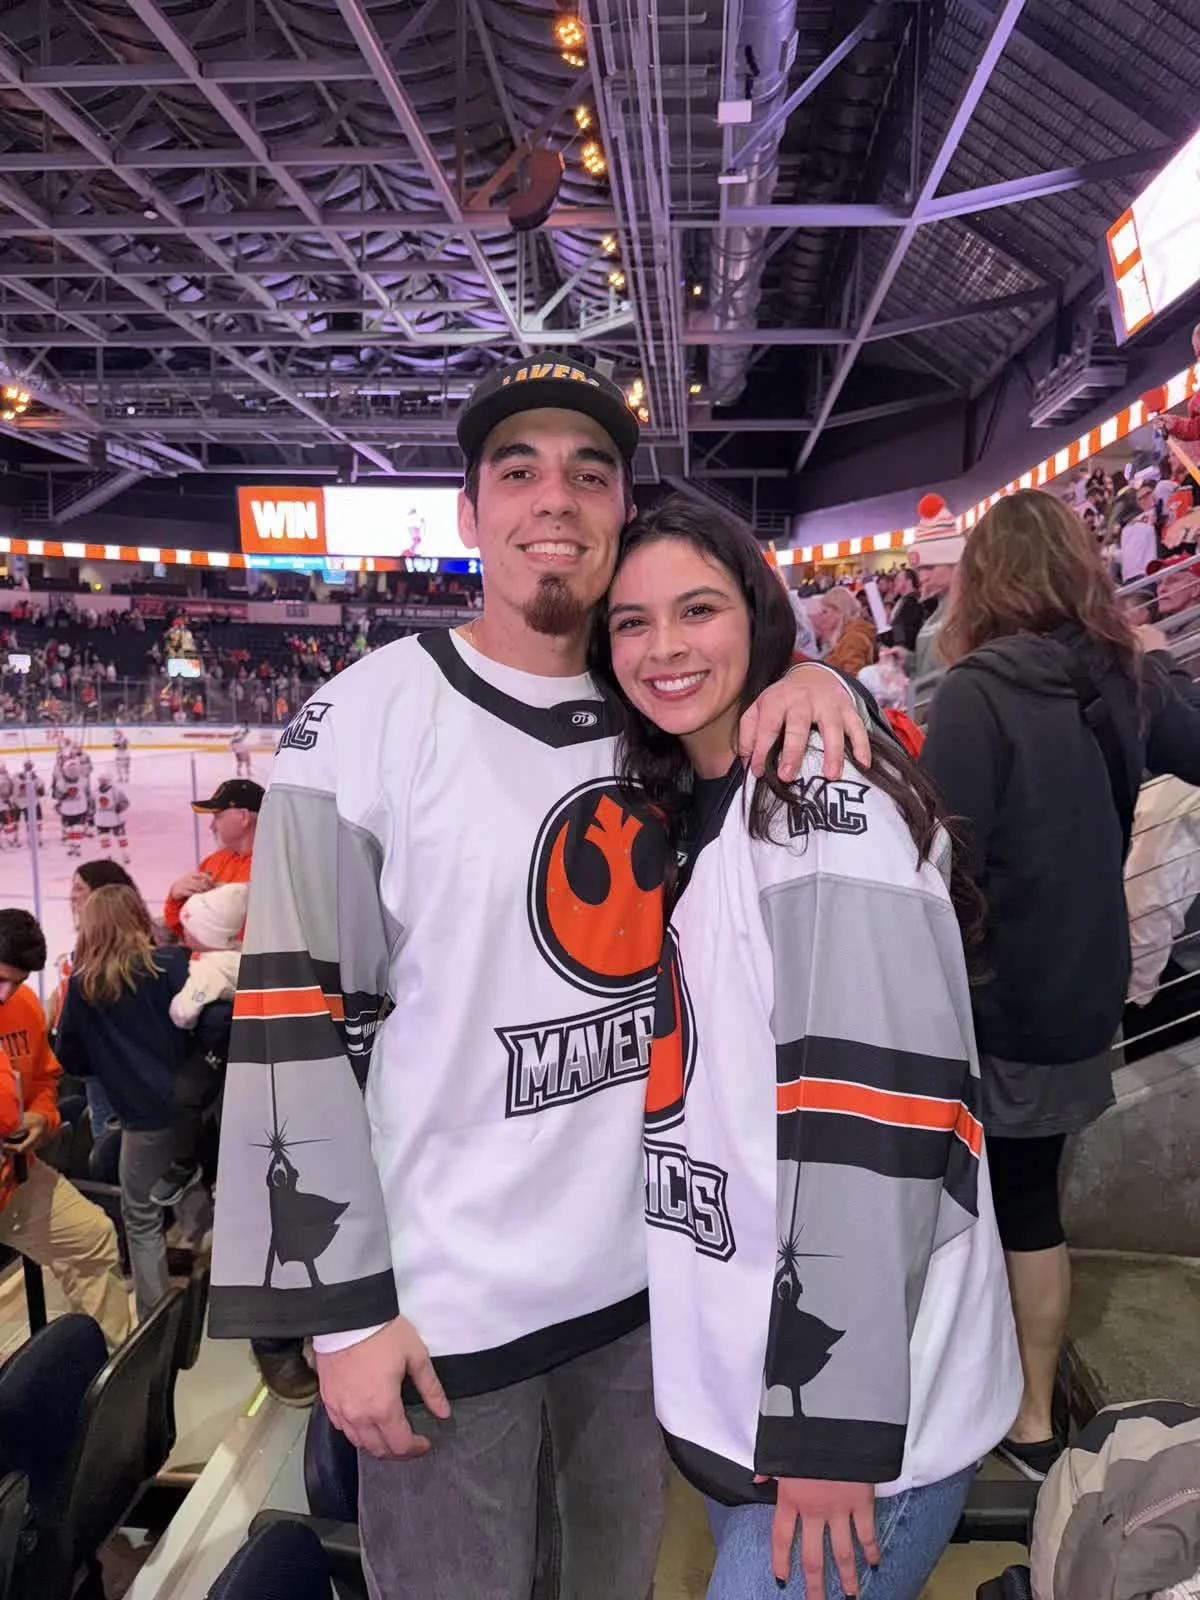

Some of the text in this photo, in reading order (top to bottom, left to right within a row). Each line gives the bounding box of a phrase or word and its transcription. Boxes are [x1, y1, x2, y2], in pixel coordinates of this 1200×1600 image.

[251, 500, 318, 540] WIN
[468, 559, 478, 574] 2
[275, 702, 334, 756] C
[787, 775, 871, 838] KC
[0, 1029, 31, 1057] ITY
[645, 1148, 727, 1250] ICS
